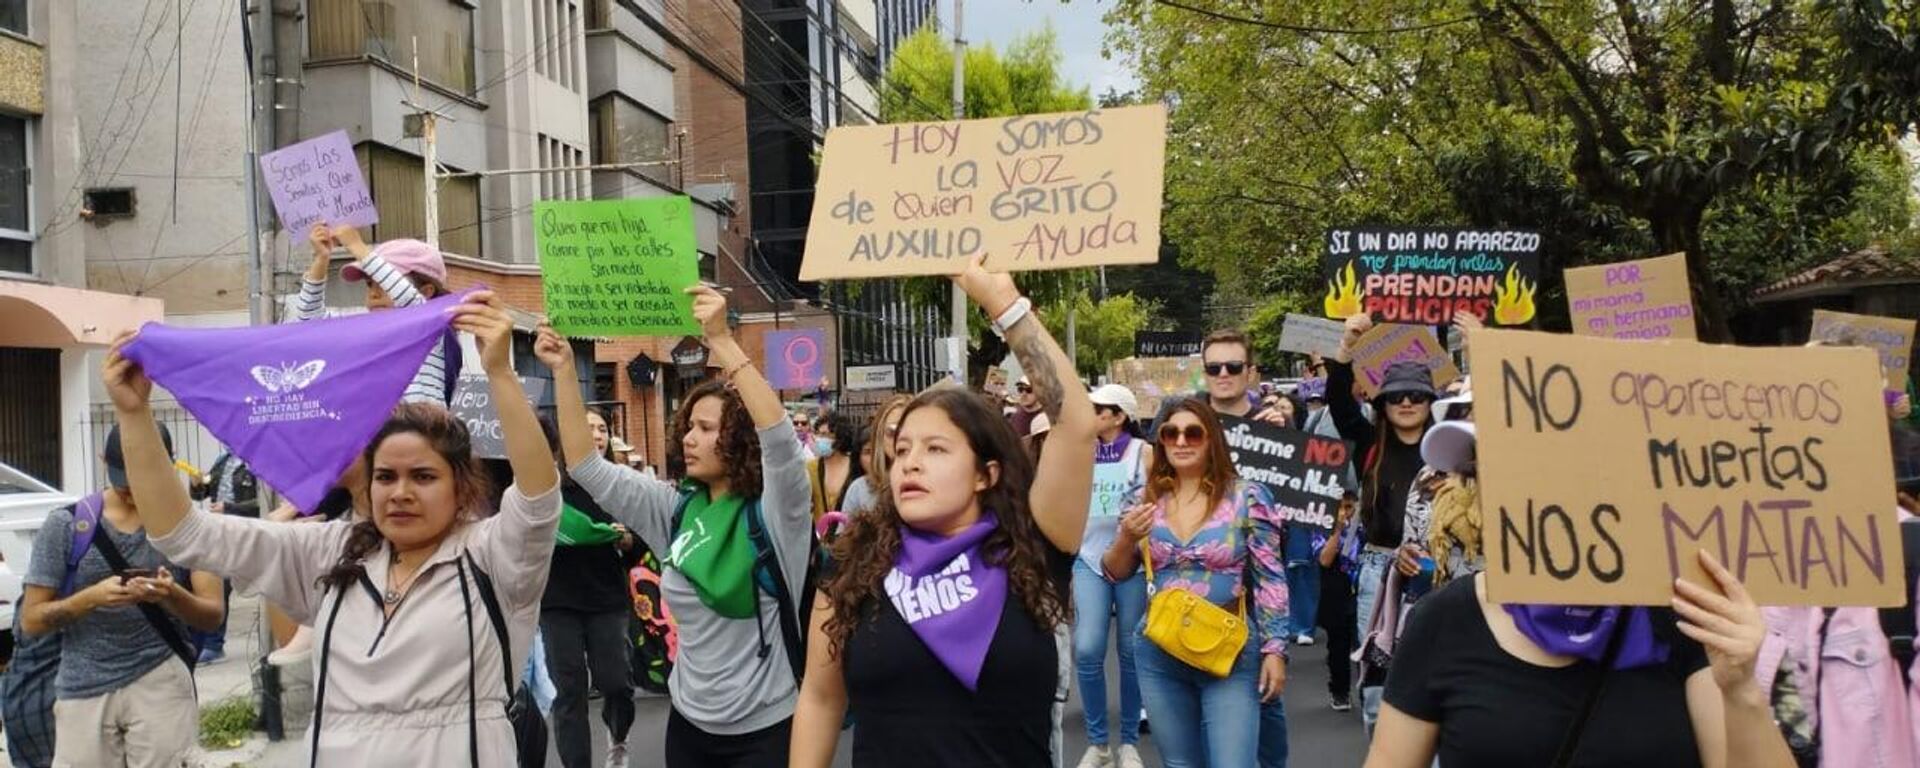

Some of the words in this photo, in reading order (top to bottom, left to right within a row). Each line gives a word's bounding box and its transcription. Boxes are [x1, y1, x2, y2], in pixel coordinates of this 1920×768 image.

[884, 123, 960, 164] HOY
[996, 111, 1103, 155] SOMOS
[996, 154, 1075, 191] VOZ
[831, 190, 875, 224] de
[893, 191, 973, 221] Quien
[849, 228, 981, 262] AUXILIO
[1330, 230, 1351, 254] SI
[1359, 232, 1380, 250] UN
[1388, 232, 1417, 250] DIA
[1424, 232, 1448, 250] NO
[1455, 231, 1540, 252] APAREZCO
[1365, 273, 1495, 297] PRENDAN
[1501, 356, 1582, 433] NO
[1611, 371, 1842, 433] aparecemos
[1304, 437, 1346, 466] NO
[1499, 498, 1624, 583] NOS
[1661, 499, 1885, 590] MATAN
